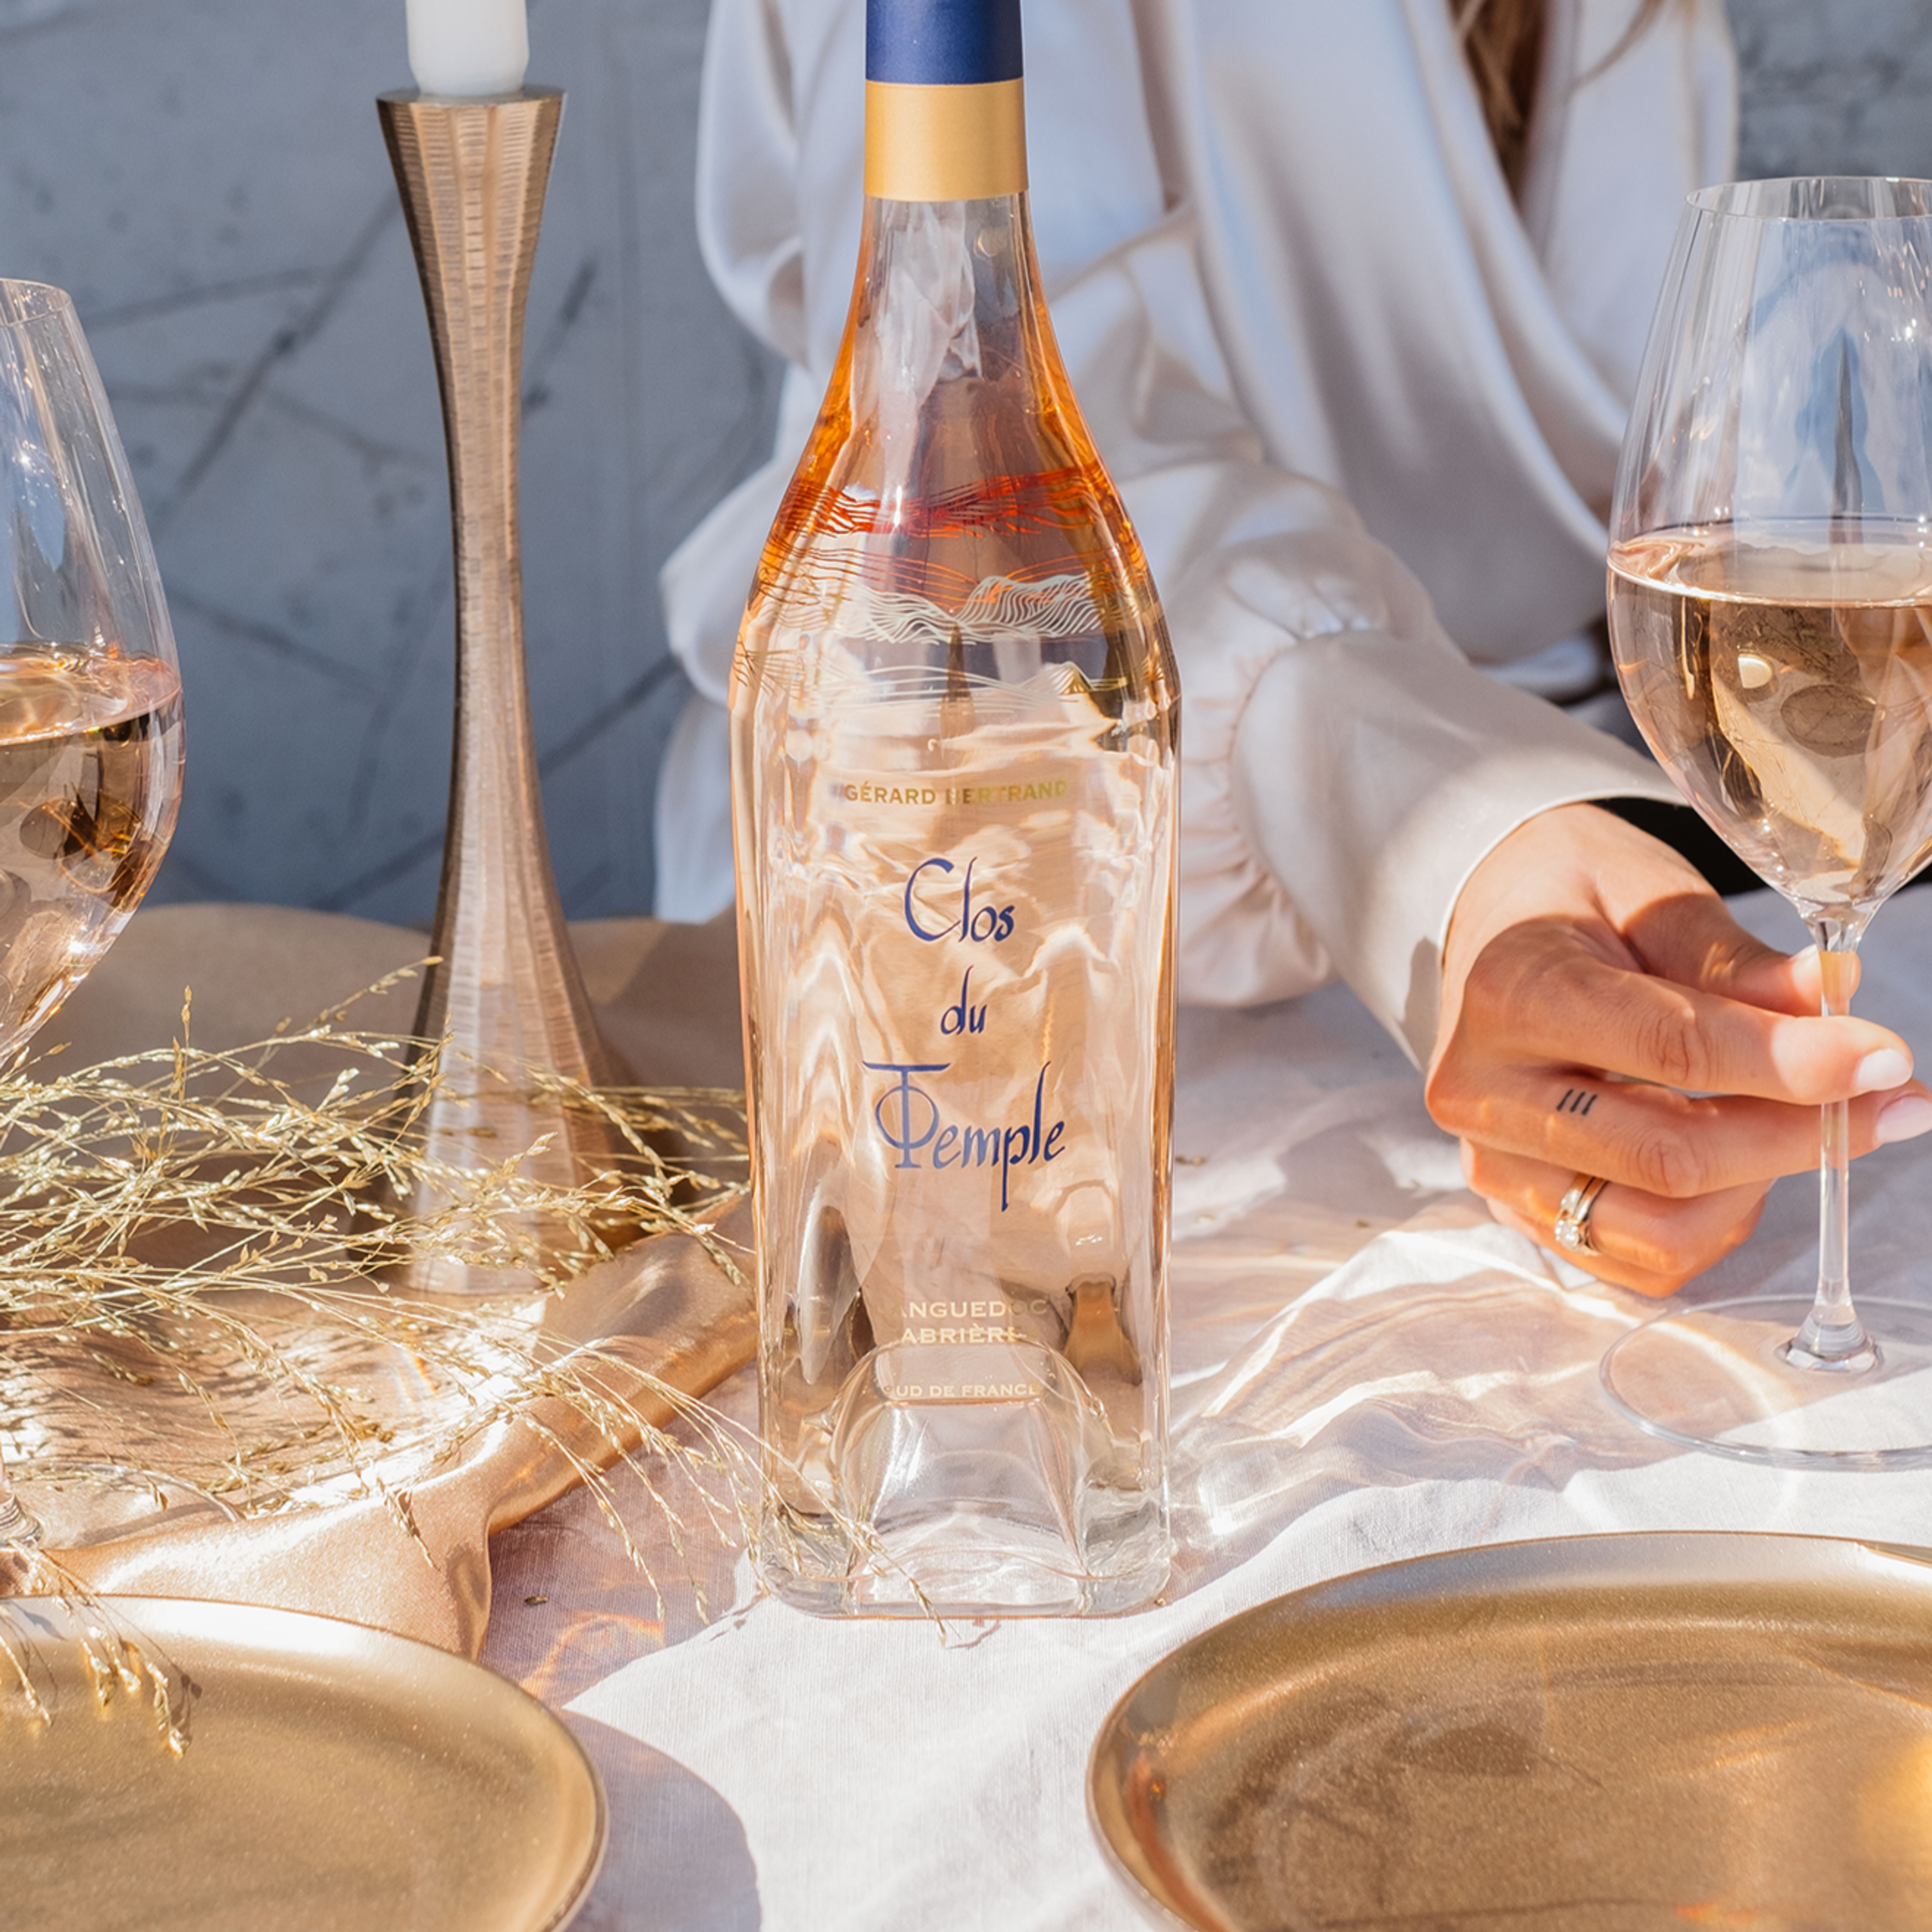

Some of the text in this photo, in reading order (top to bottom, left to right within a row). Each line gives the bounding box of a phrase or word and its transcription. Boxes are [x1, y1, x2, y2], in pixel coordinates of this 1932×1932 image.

[843, 780, 936, 804] GÉRARD
[904, 856, 1015, 942] Clos
[940, 964, 987, 1035] du
[862, 1061, 1066, 1212] Temple
[929, 1385, 955, 1397] DE
